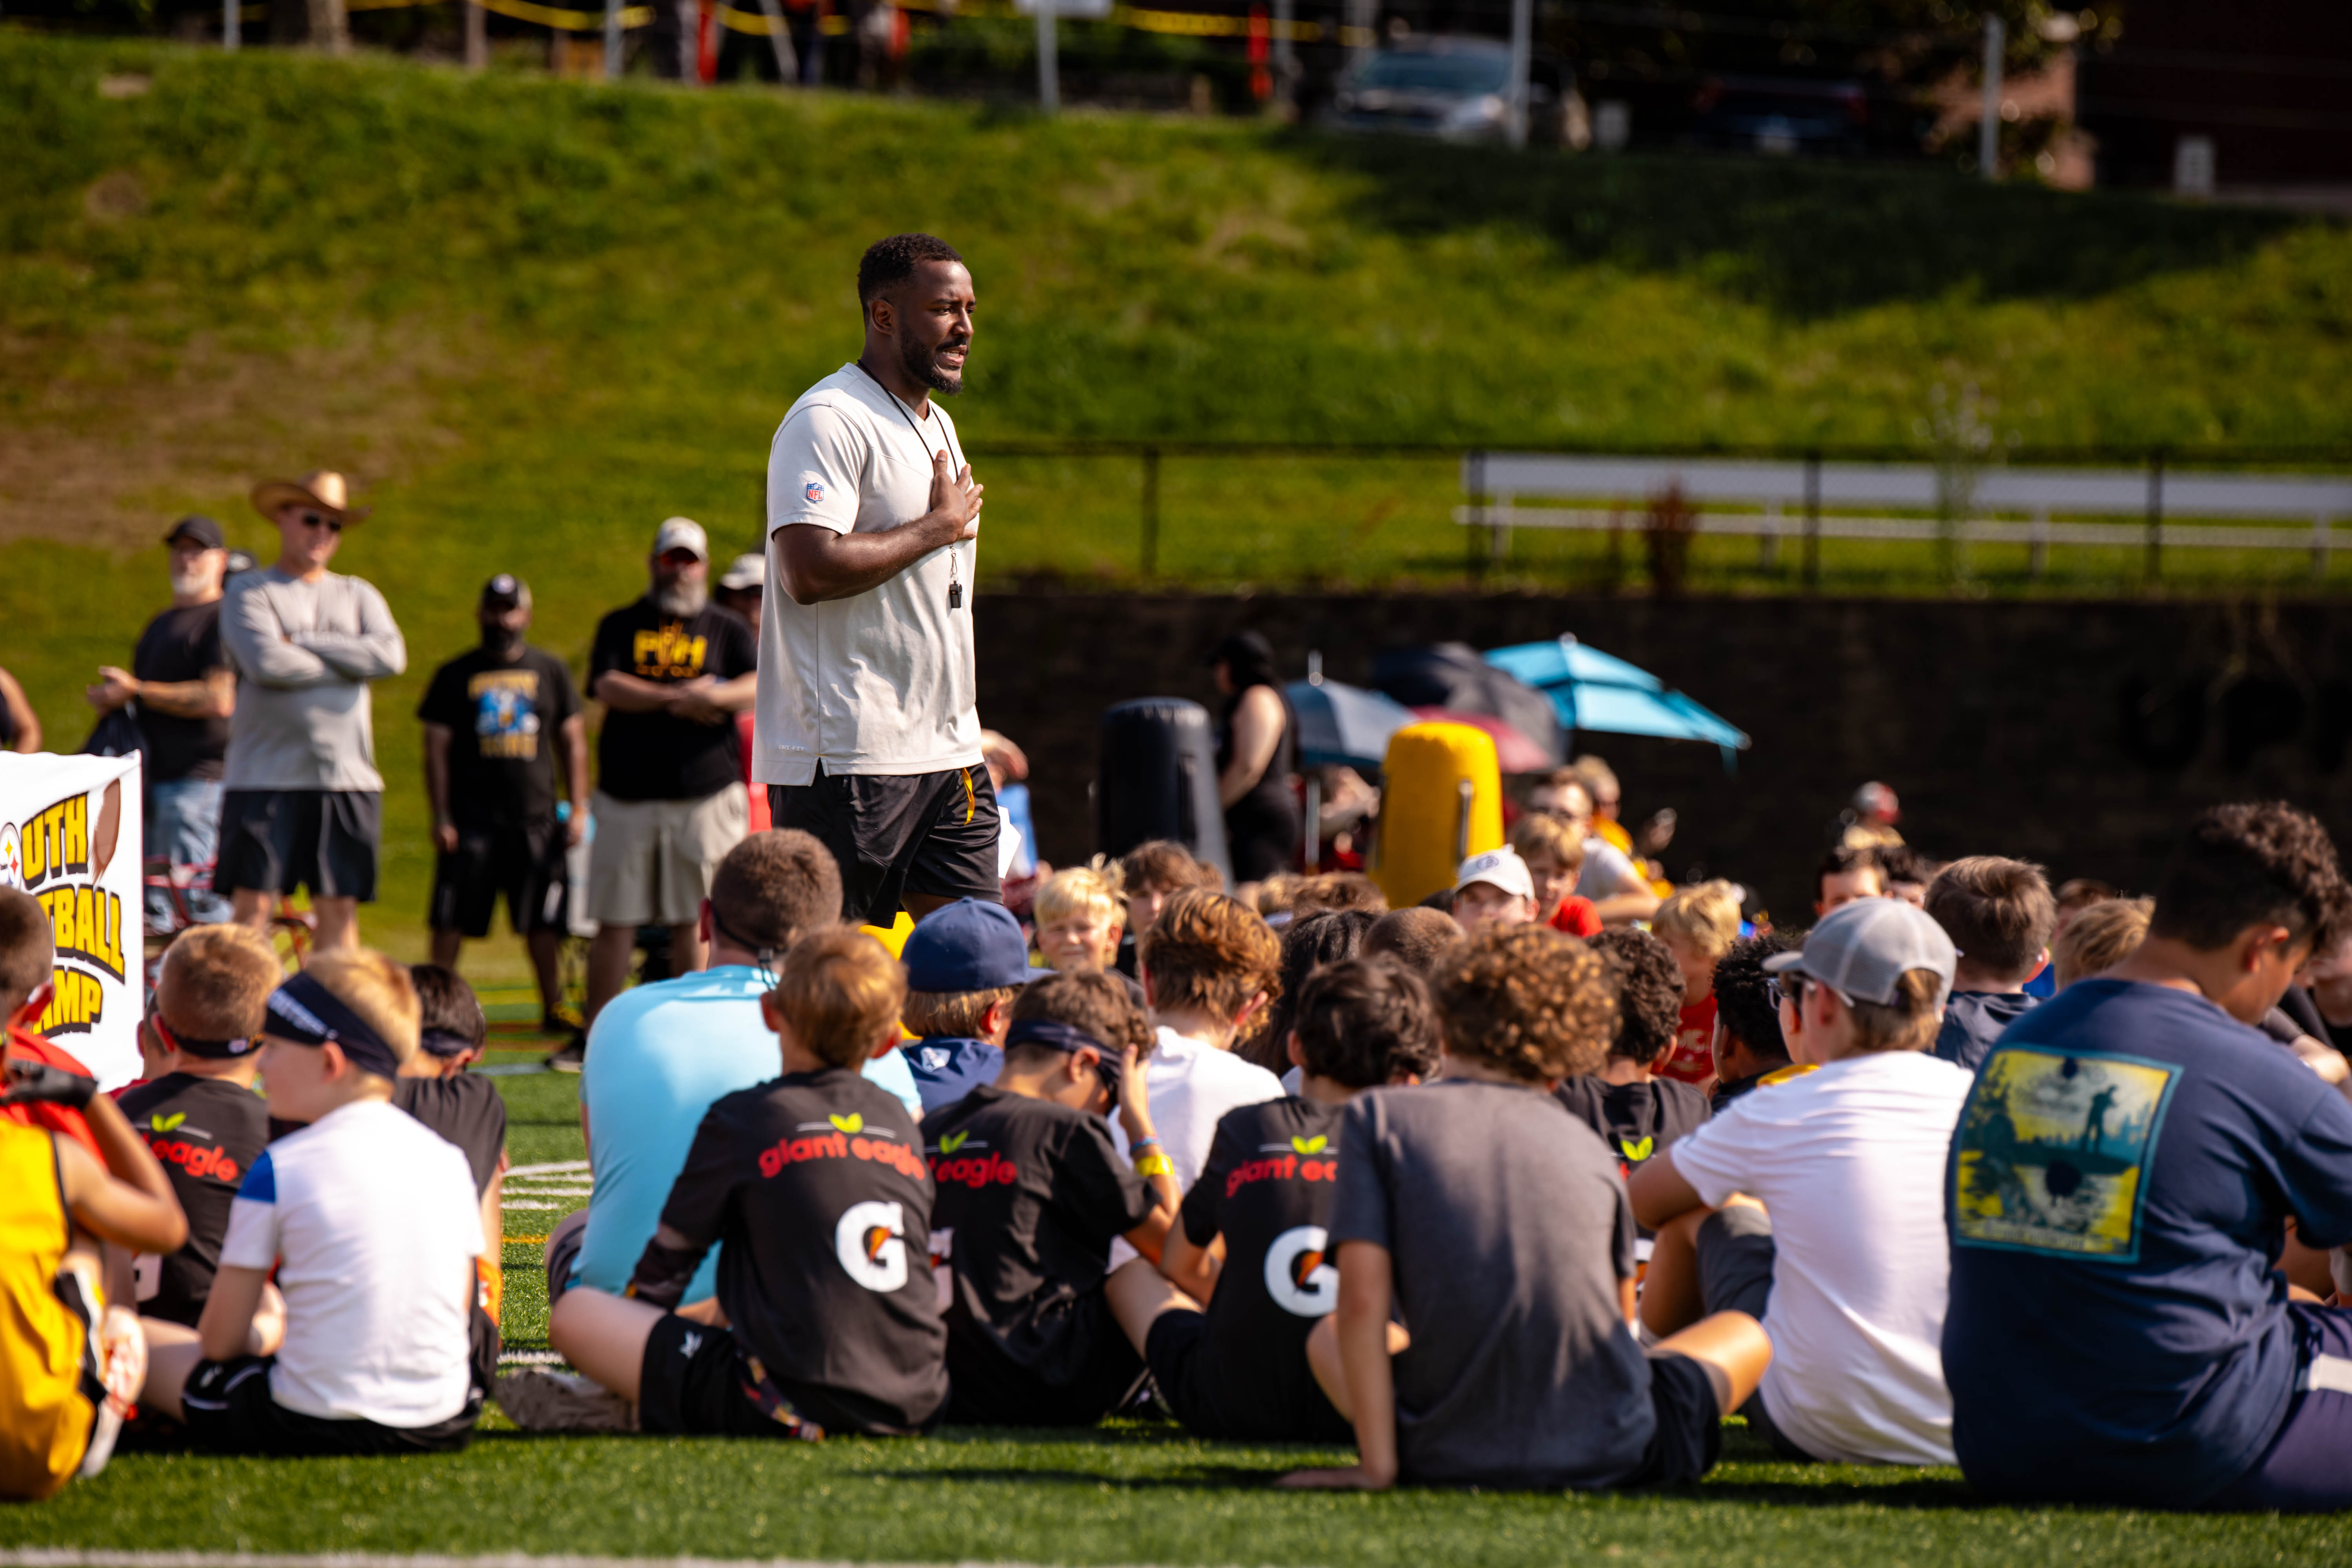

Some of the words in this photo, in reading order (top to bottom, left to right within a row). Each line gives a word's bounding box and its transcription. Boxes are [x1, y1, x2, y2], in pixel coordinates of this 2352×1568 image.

[808, 490, 822, 500] NFL
[758, 1131, 848, 1179] giant
[935, 1150, 1017, 1189] eagle
[1225, 1153, 1299, 1199] giant
[835, 1200, 908, 1292] G
[1263, 1224, 1339, 1318] G
